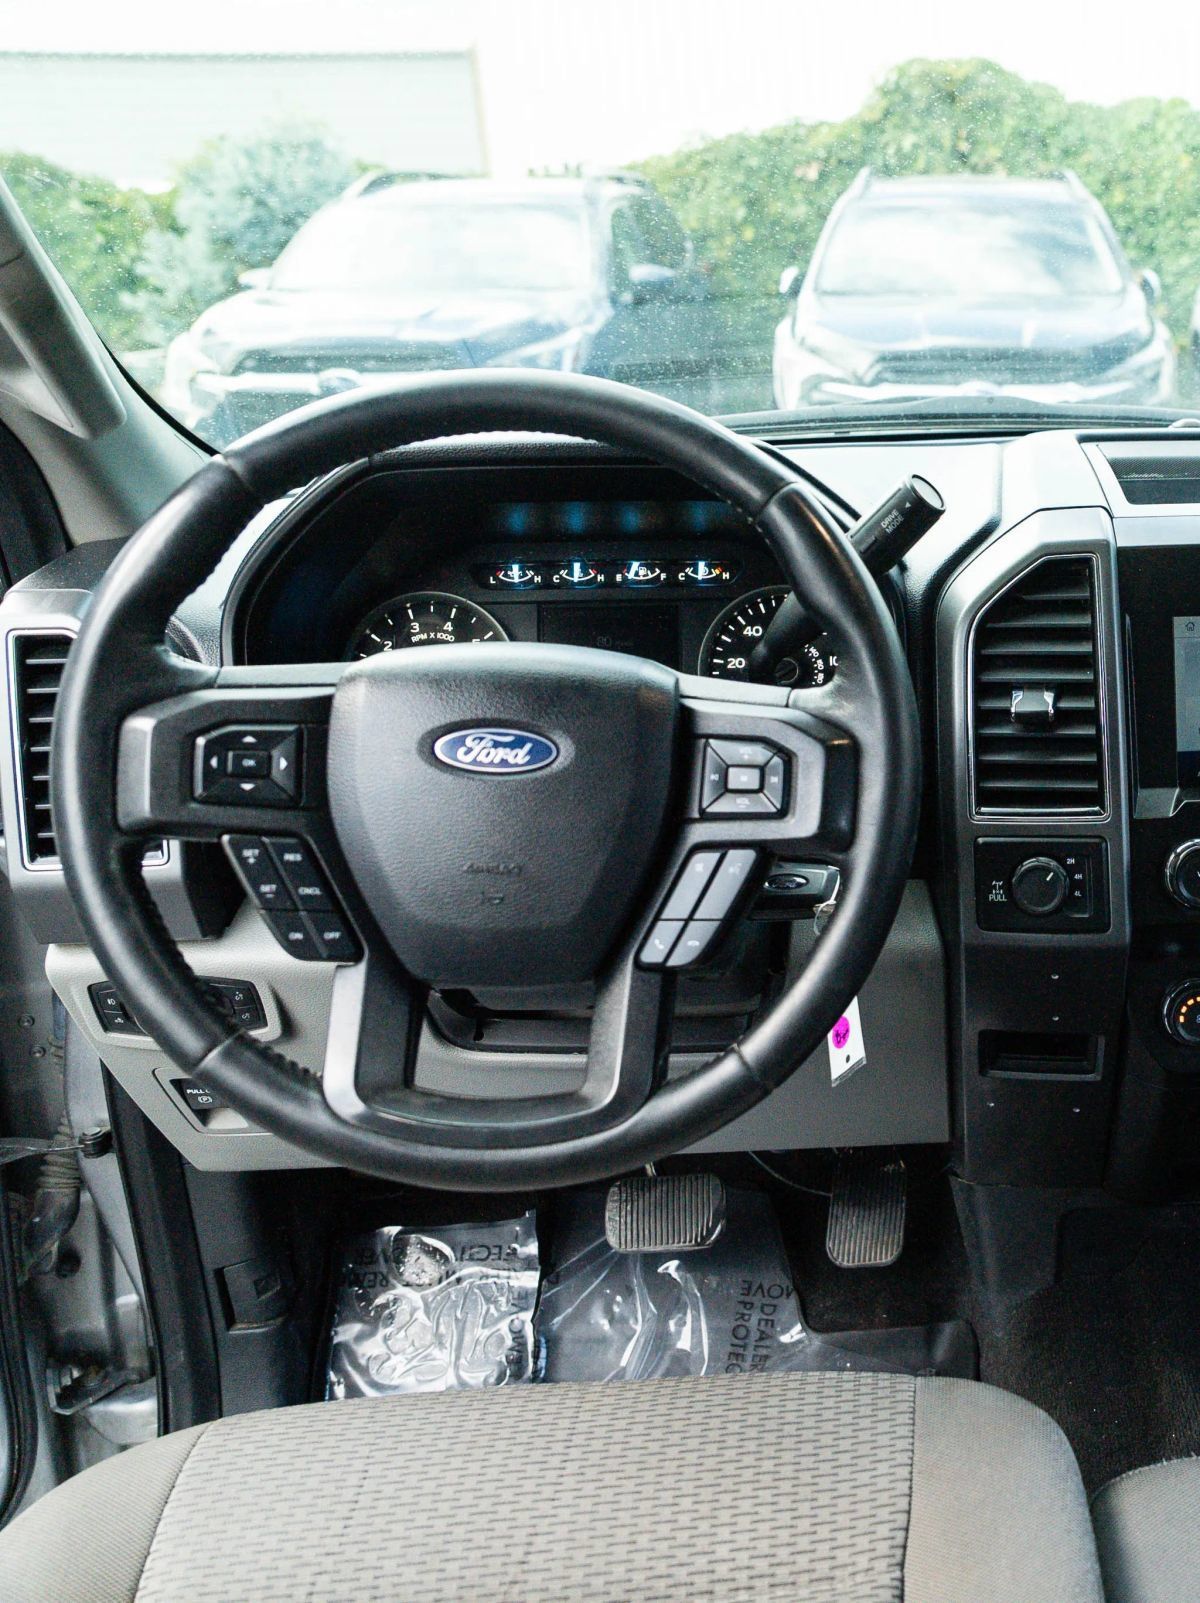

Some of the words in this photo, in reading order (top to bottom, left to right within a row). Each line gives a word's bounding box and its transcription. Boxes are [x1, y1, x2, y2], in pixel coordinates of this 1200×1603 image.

[881, 509, 900, 528] DRIVE
[489, 576, 496, 584] L
[534, 575, 542, 583] H
[553, 575, 560, 583] C
[597, 574, 605, 582] H
[615, 574, 623, 582] E
[660, 573, 668, 581] F
[678, 572, 686, 580] C
[722, 572, 730, 580] H
[410, 622, 420, 633] 3
[443, 621, 454, 632] 4
[743, 625, 763, 637] 40
[411, 633, 428, 643] RPM
[436, 632, 455, 642] 1000
[383, 641, 393, 651] 2
[727, 657, 746, 669] 20
[456, 732, 533, 765] Ford
[988, 894, 1007, 902] PULL
[725, 1300, 755, 1374] PROTEC
[749, 1302, 777, 1372] DEALER
